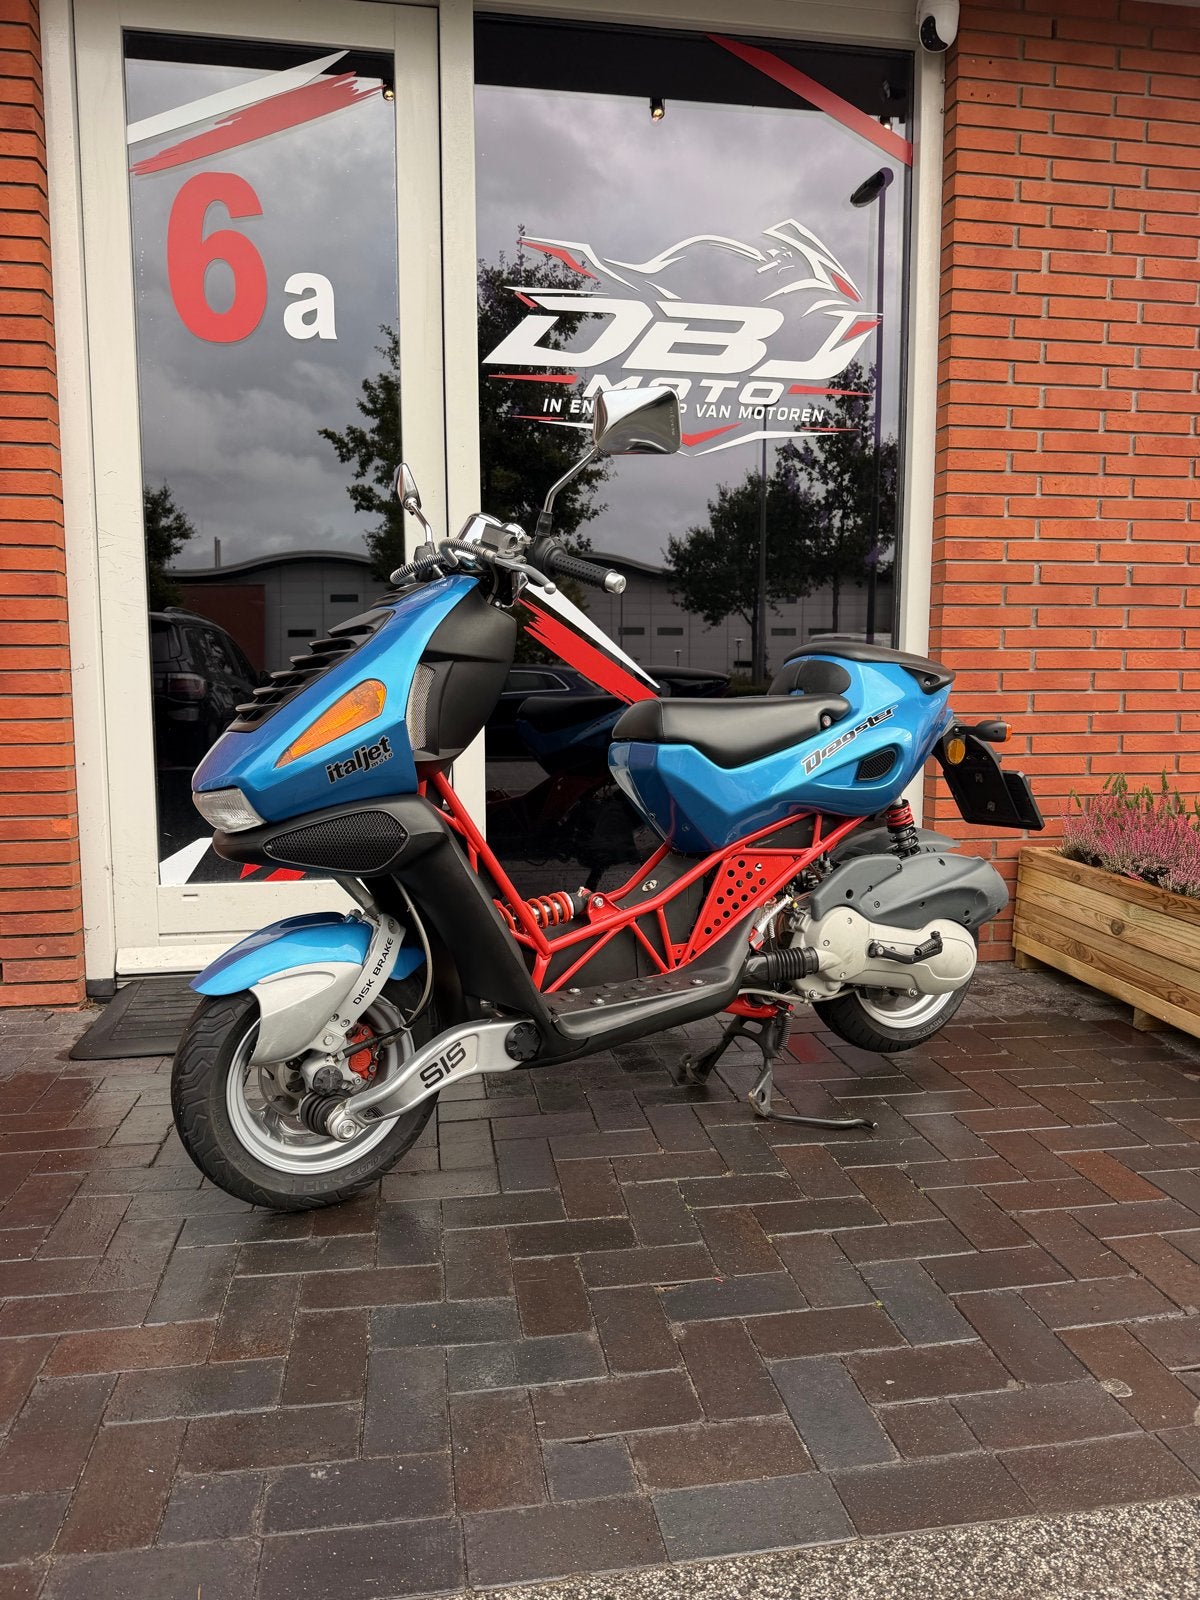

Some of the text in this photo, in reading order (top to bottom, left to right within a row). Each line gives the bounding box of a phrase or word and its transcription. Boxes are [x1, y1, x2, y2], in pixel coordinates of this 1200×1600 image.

[482, 296, 882, 380] DBJ
[542, 398, 562, 413] IN
[695, 404, 731, 419] VAN
[738, 406, 825, 423] MOTOREN
[325, 735, 392, 784] italjet
[801, 704, 898, 776] Dragster
[352, 937, 394, 1006] DISK BRAKE
[420, 1041, 467, 1089] SIS
